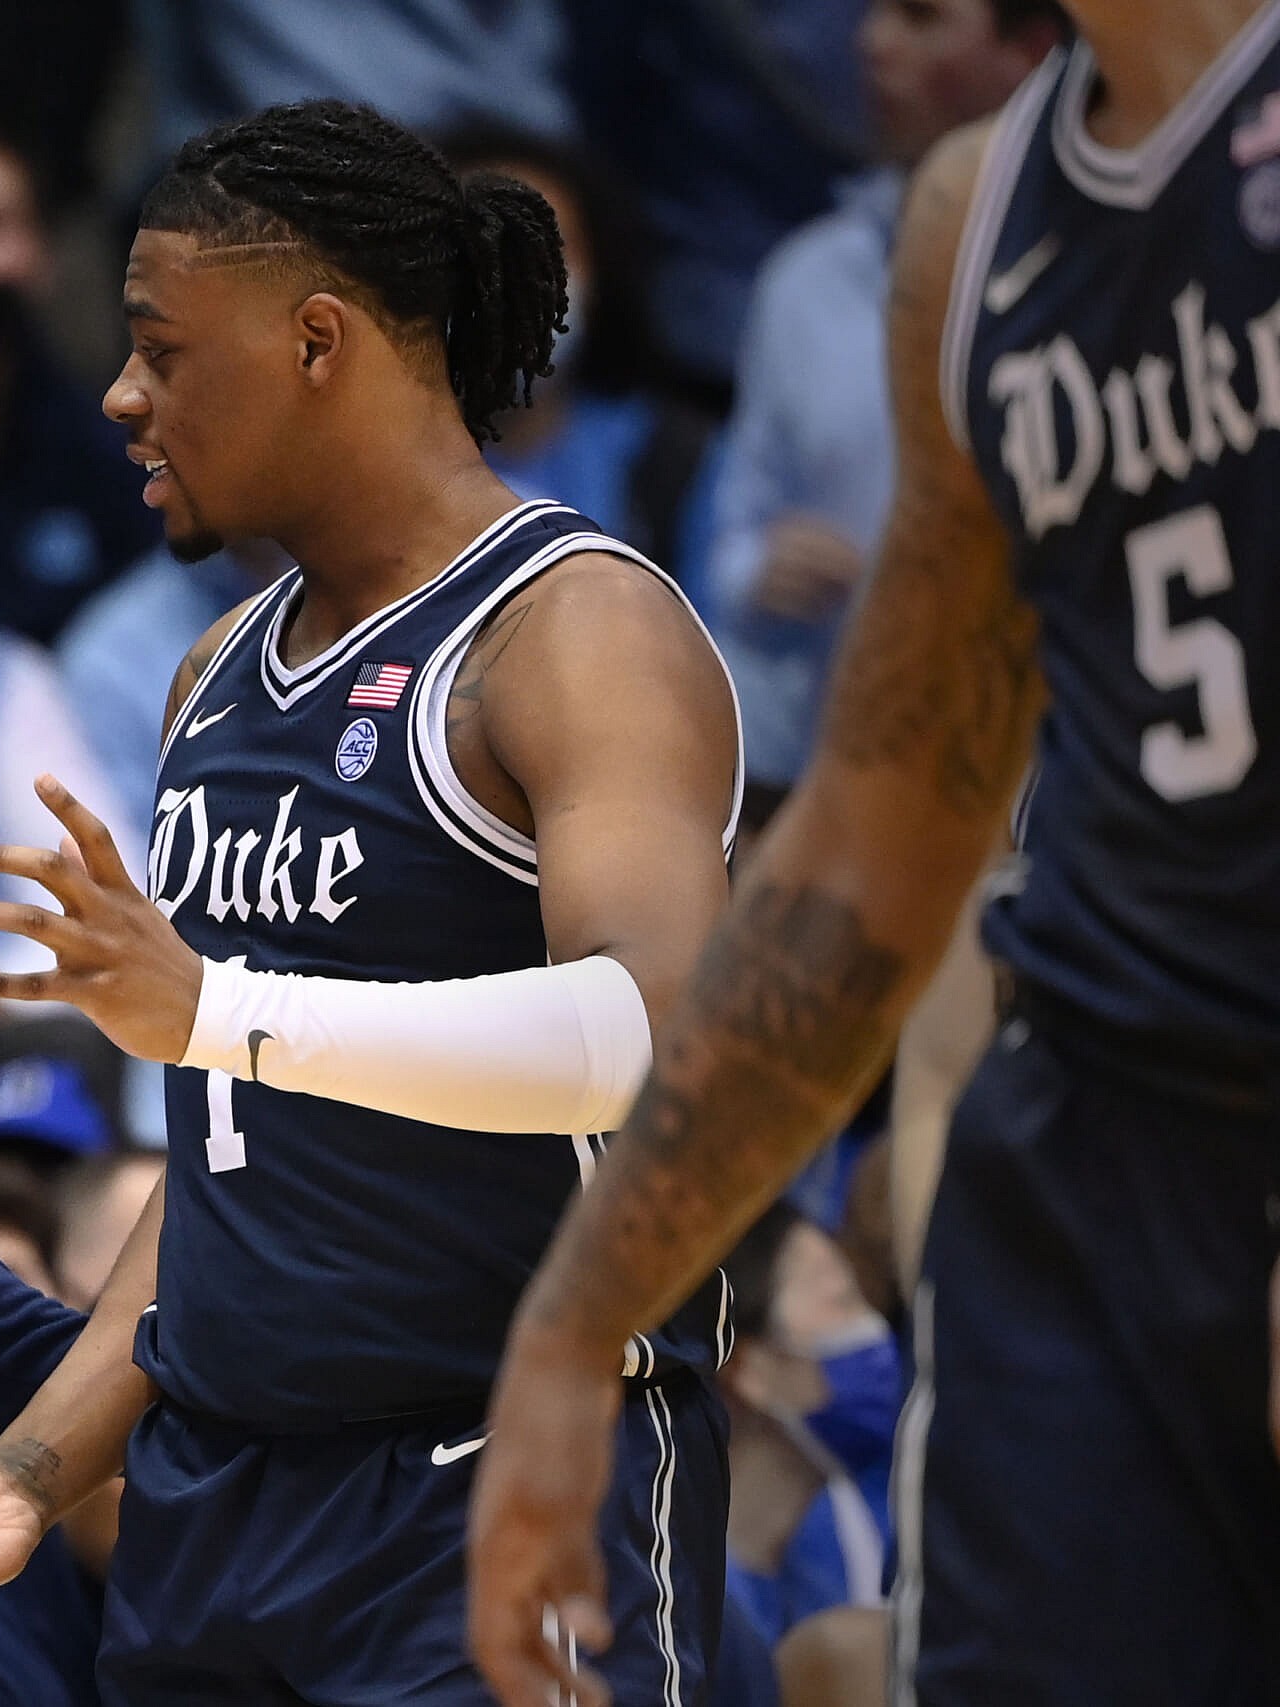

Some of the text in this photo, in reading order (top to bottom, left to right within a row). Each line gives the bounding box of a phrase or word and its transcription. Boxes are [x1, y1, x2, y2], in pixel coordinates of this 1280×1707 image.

[1125, 503, 1257, 801] 5
[343, 740, 375, 754] ACC
[148, 784, 365, 924] Duke
